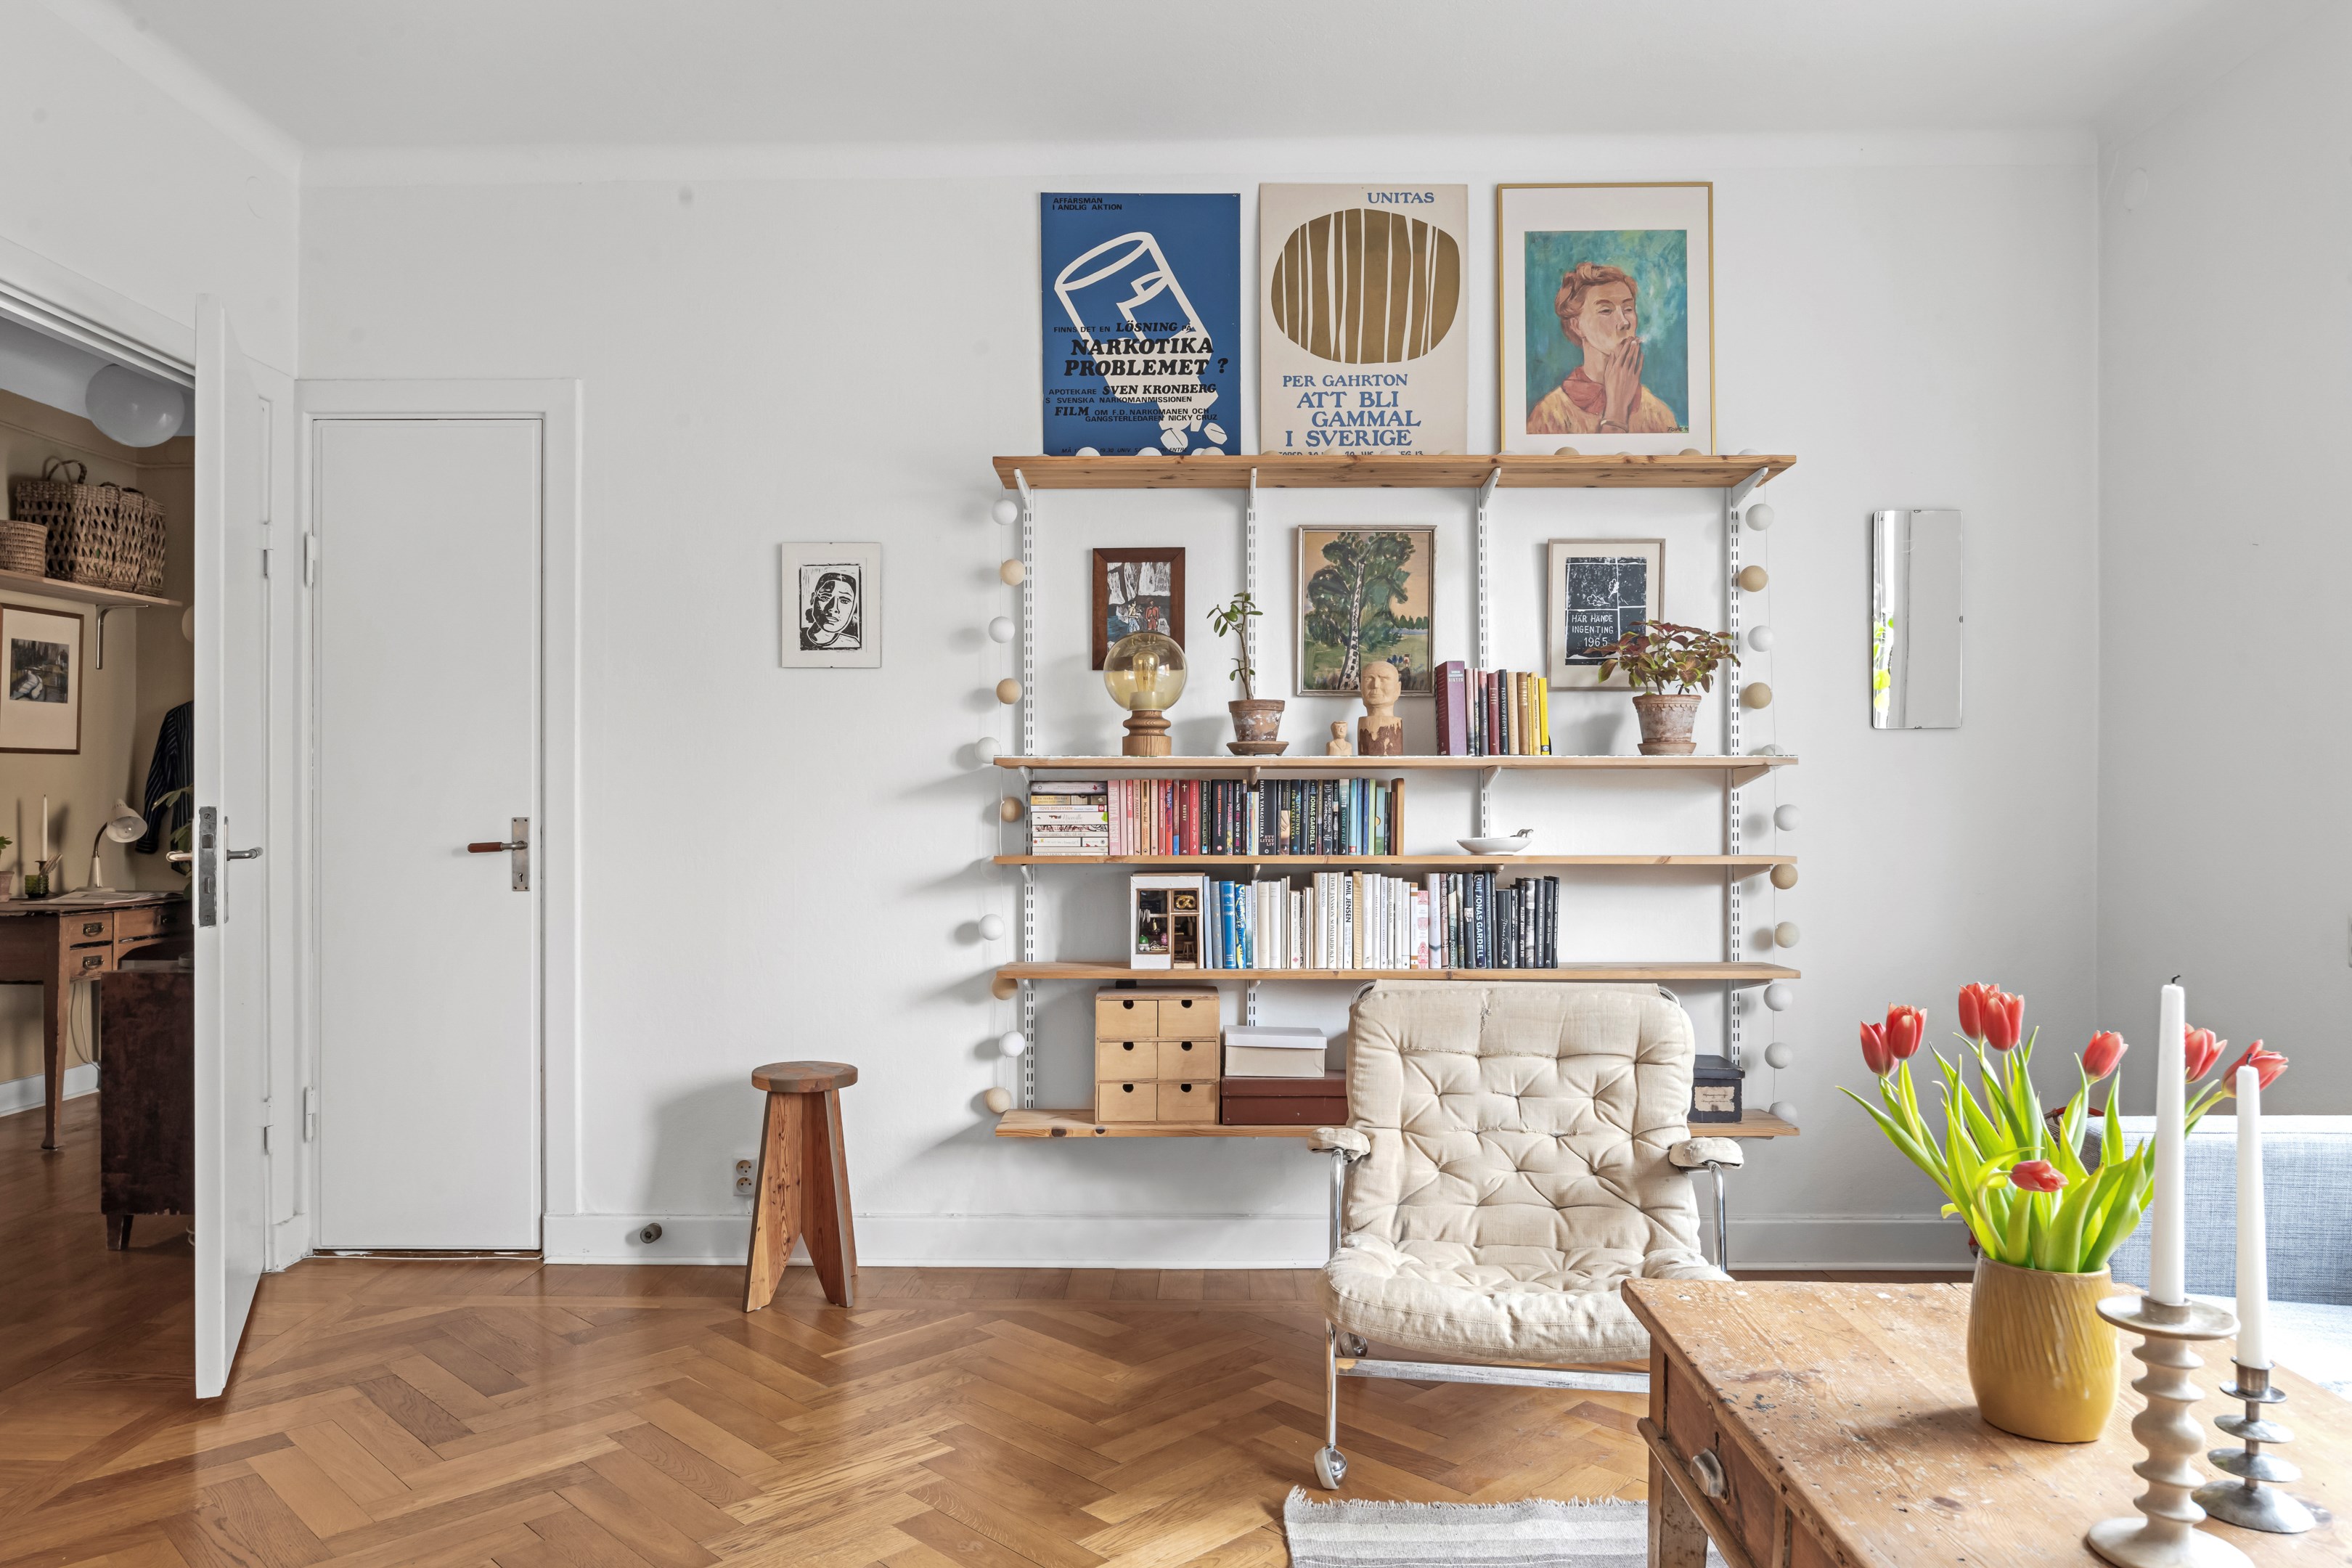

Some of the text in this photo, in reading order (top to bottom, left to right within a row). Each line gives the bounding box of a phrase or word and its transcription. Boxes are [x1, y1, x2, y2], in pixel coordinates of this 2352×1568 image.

[1367, 192, 1434, 204] UNITAS
[1116, 320, 1177, 332] LÖSNING
[1181, 323, 1192, 331] PÅ
[1071, 337, 1214, 355] NARKOTIKA
[1064, 358, 1229, 376] PROBLEMET ?
[1282, 373, 1408, 387] PER GAHRTON
[1103, 385, 1139, 395] SVEN
[1142, 383, 1217, 395] KRONBERG
[1297, 391, 1399, 408] ATT BLI
[1054, 406, 1089, 416] FILM
[1311, 410, 1421, 427] GAMMAL
[1286, 429, 1412, 447] I SVERIGE
[1572, 614, 1613, 623] HÄR HÄNDE
[1572, 625, 1614, 634] INGENTING
[1584, 637, 1608, 647] 1965
[1109, 787, 1119, 842] DEN VITA ROSEN
